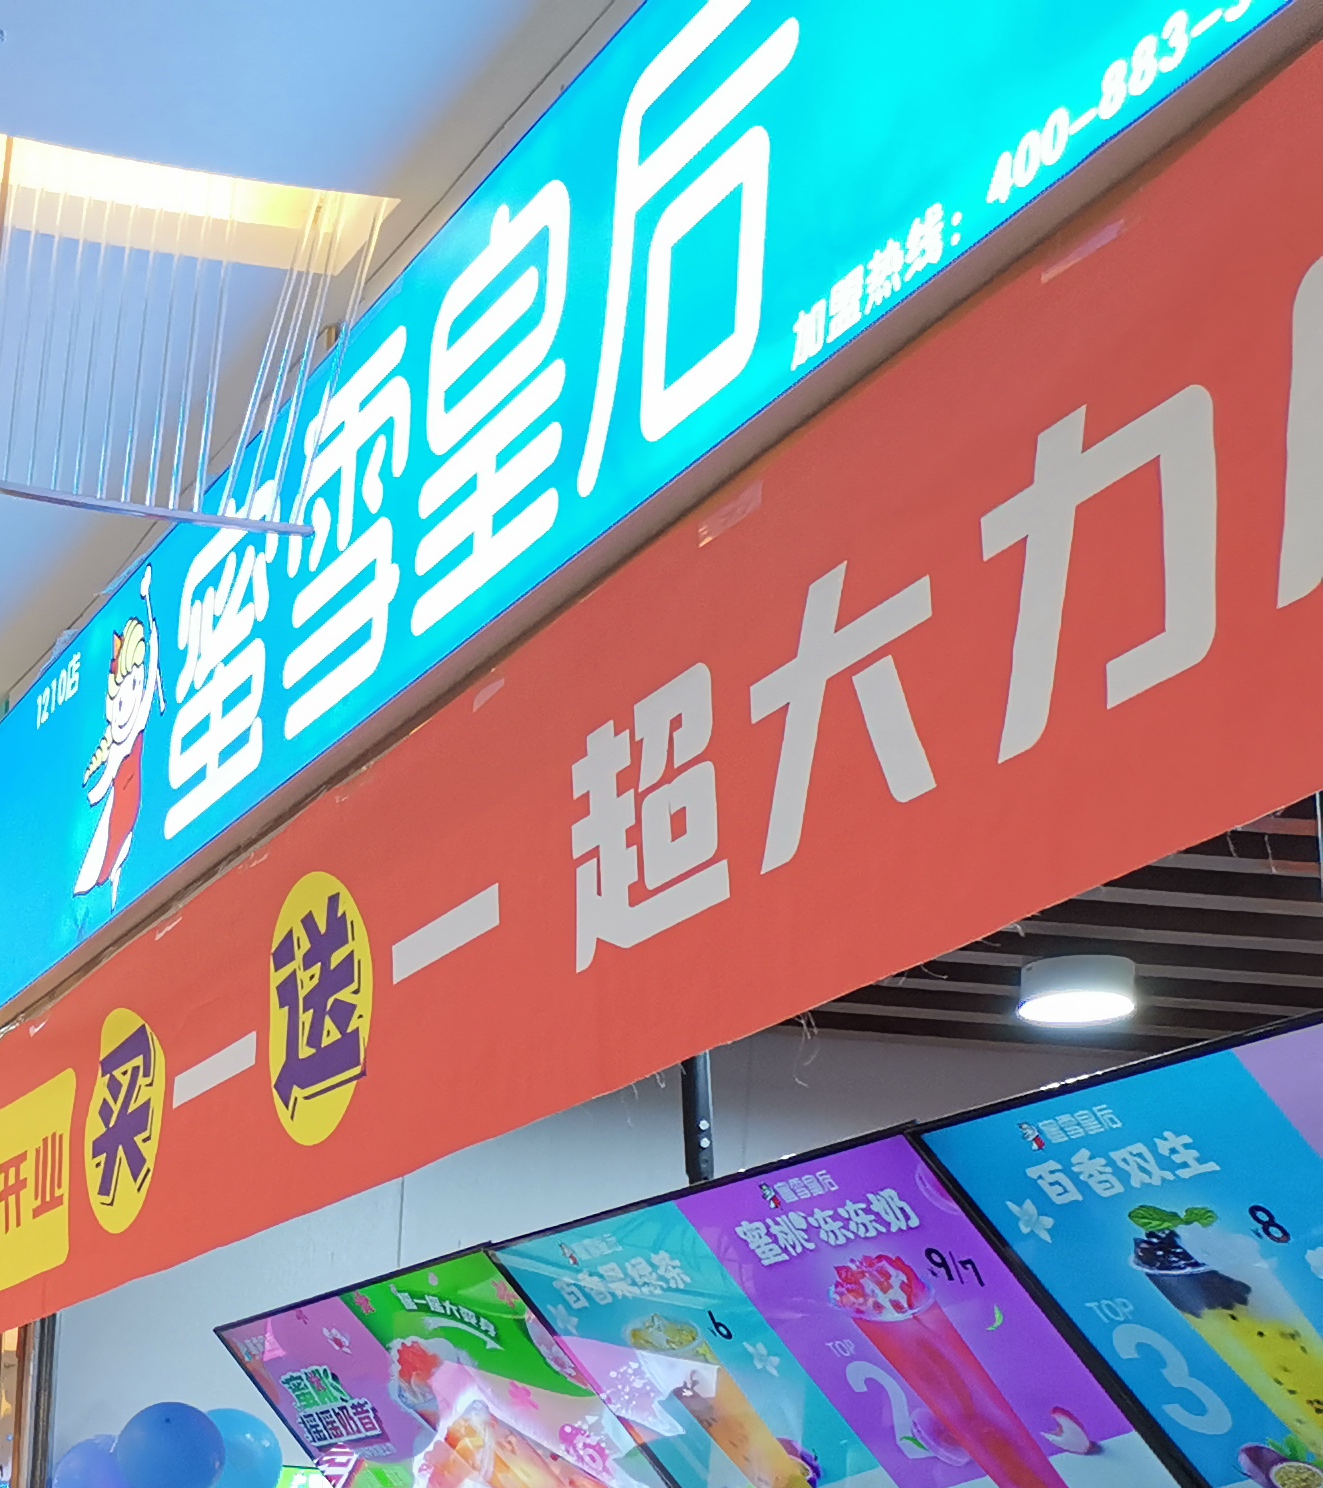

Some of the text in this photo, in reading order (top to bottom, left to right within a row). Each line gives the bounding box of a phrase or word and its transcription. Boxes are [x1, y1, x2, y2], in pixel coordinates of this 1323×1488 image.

[572, 255, 1323, 974] 超大力
[36, 652, 81, 730] 1210店
[1025, 1130, 1222, 1205] 百香双生
[825, 1339, 855, 1359] TOP
[1084, 1297, 1134, 1324] TOP
[845, 1359, 938, 1461] 2
[1112, 1323, 1233, 1436] 3
